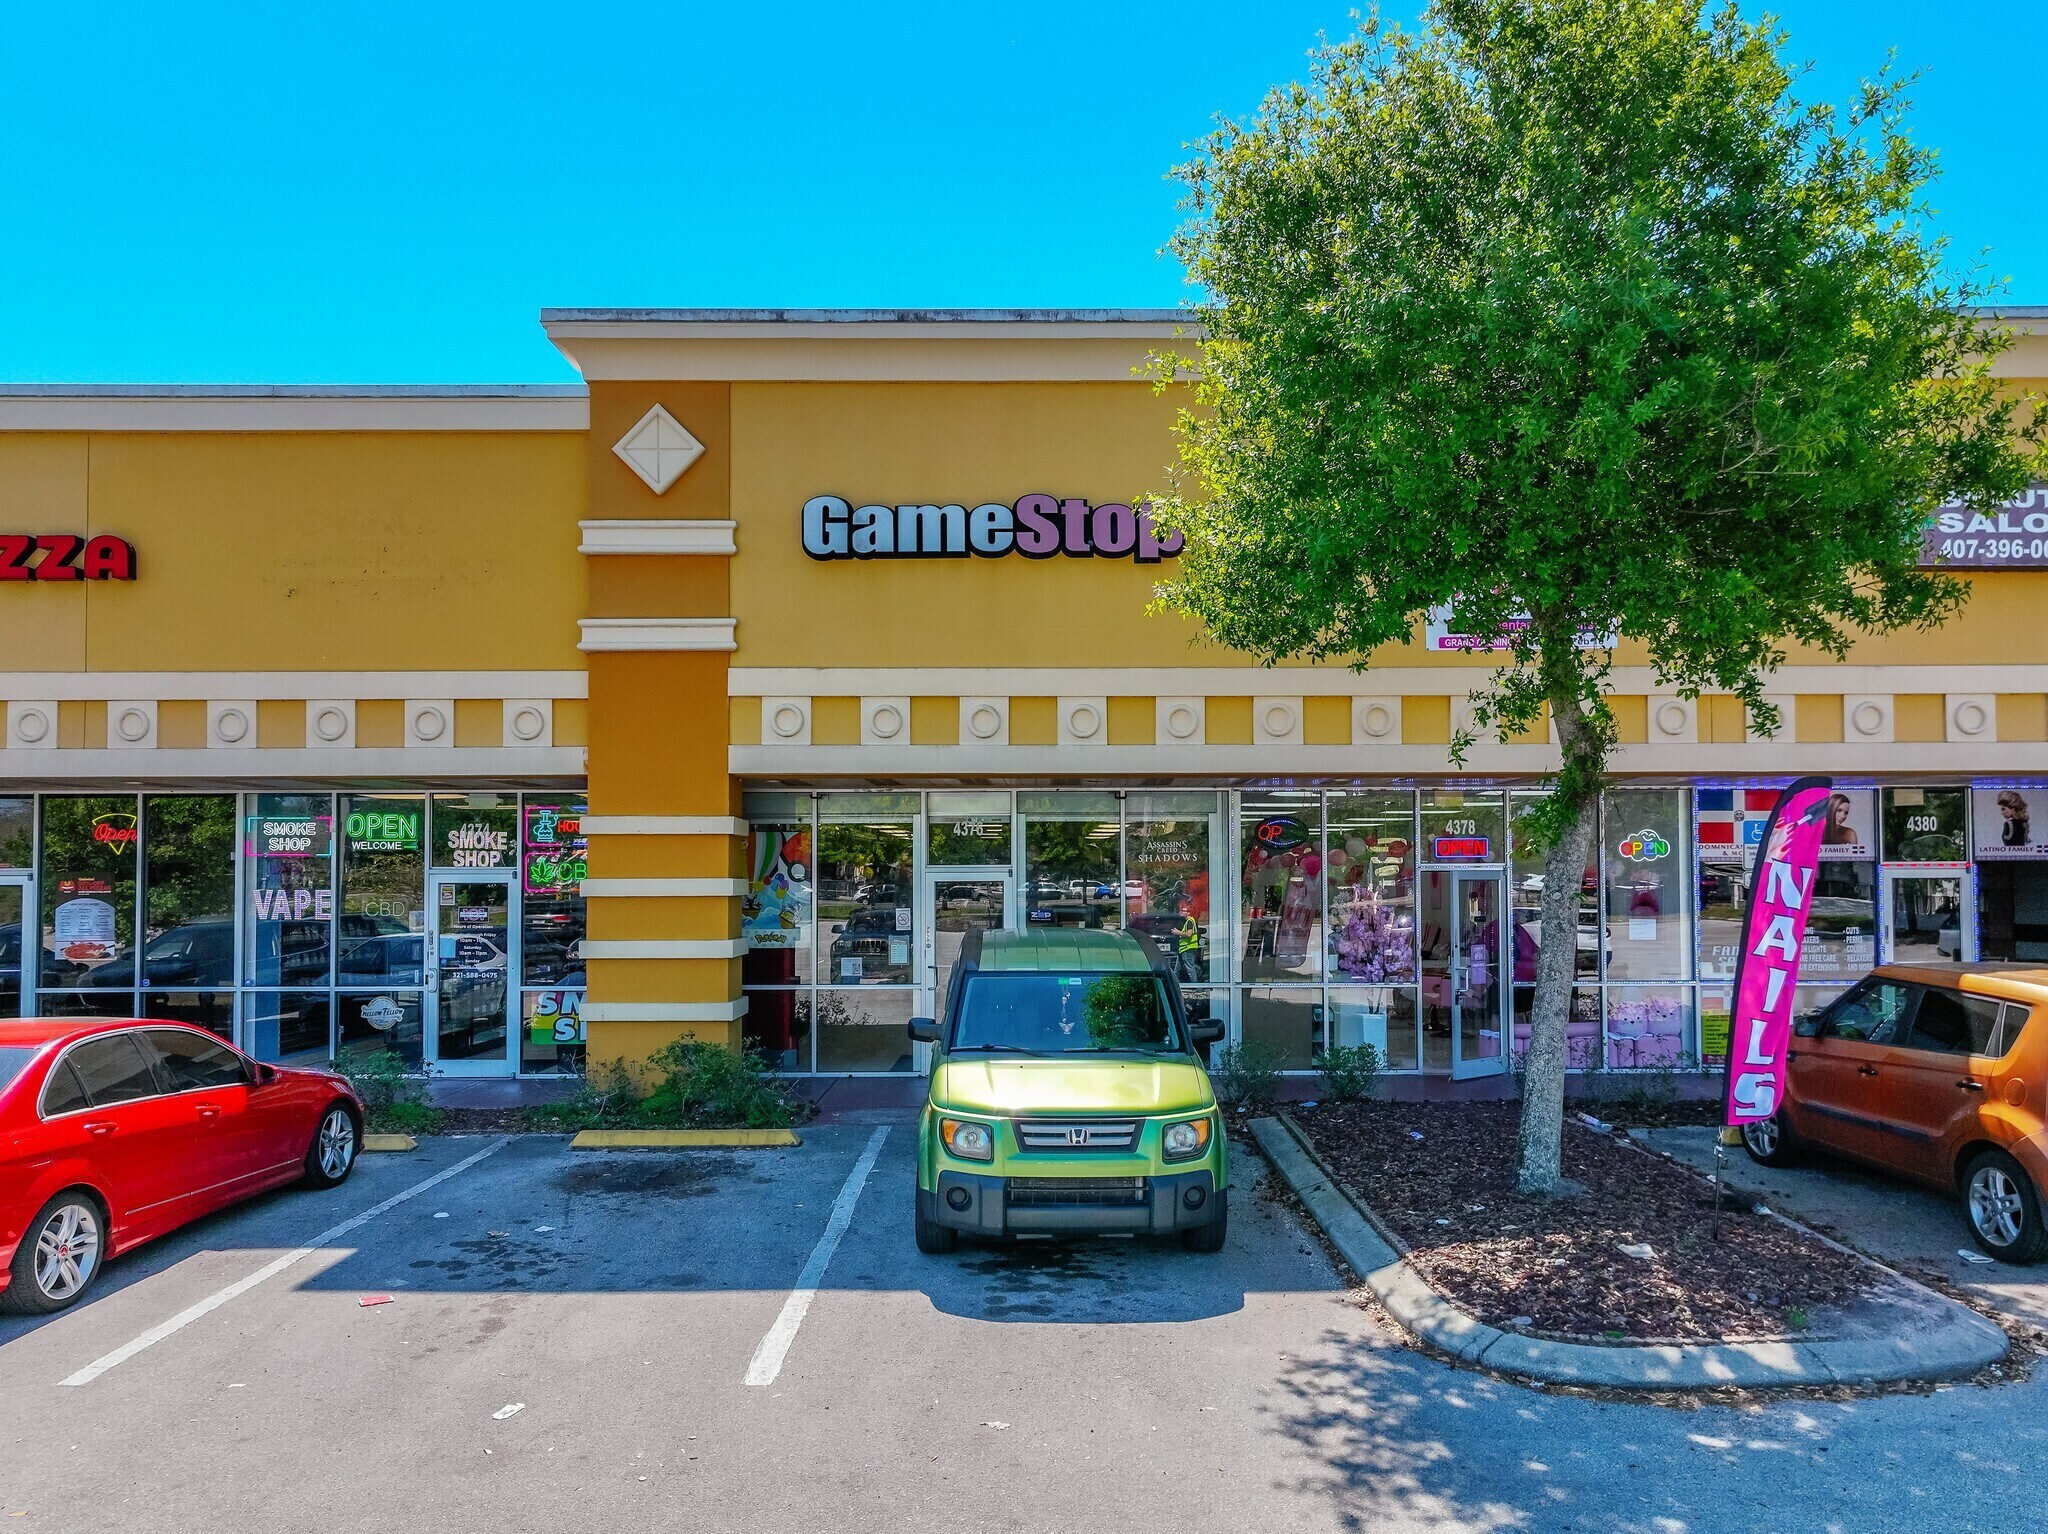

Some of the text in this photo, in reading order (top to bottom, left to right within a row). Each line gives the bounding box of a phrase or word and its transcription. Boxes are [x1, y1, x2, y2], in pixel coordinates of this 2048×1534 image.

[802, 493, 1185, 562] GameStop
[263, 822, 316, 836] SMOKE
[348, 814, 417, 838] OPEN
[1446, 820, 1476, 835] 4378
[1907, 816, 1937, 831] 4380
[94, 823, 137, 843] Open
[447, 830, 507, 850] SMOKE
[268, 838, 311, 851] SHOP
[352, 842, 402, 850] WELCOME
[1438, 840, 1487, 856] OPEN
[1620, 841, 1666, 857] OPEN
[453, 850, 500, 867] SHOP
[1138, 854, 1198, 862] SHADOWS
[253, 889, 331, 920] VAPE
[365, 902, 405, 917] CBD
[1734, 860, 1813, 1117] NAILS
